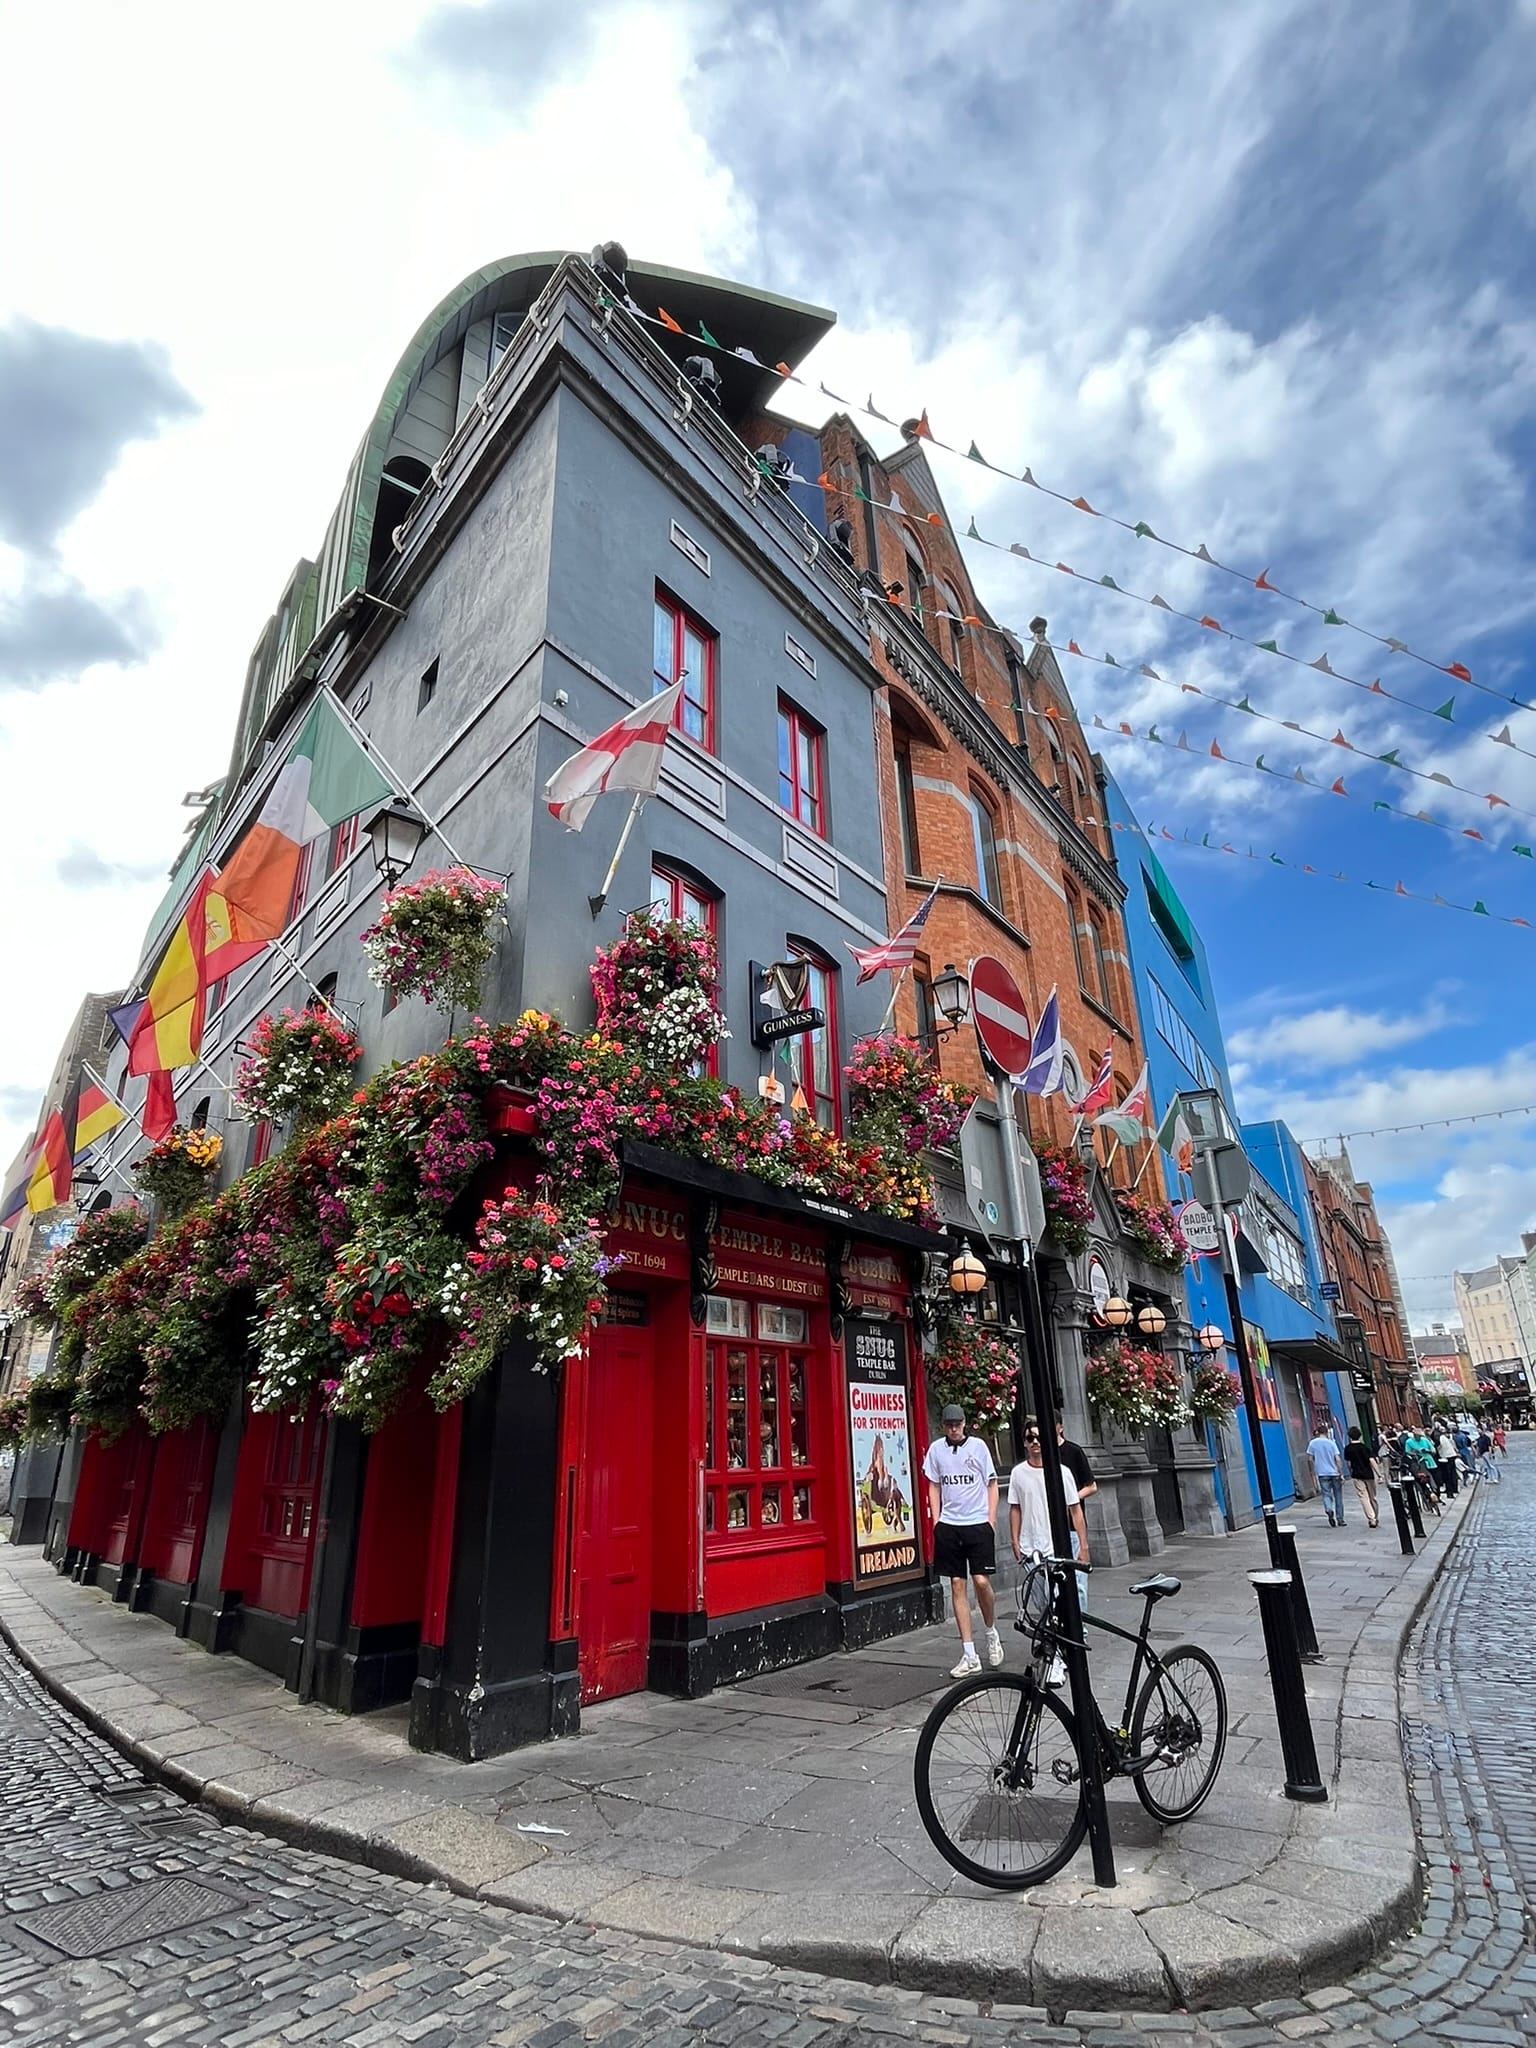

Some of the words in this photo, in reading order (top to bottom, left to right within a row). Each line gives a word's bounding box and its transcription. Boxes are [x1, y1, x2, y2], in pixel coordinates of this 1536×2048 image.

[763, 1011, 813, 1035] GUINNESS
[1183, 1213, 1213, 1225] BADBO
[1186, 1226, 1211, 1236] TEMPLE
[644, 1254, 666, 1270] 1694
[790, 1241, 826, 1268] BAR
[848, 1256, 902, 1283] DUBLIN
[717, 1266, 749, 1284] EMPLE
[776, 1277, 807, 1294] OLDEST
[869, 1326, 881, 1335] THE
[855, 1335, 895, 1359] SNUG
[856, 1357, 882, 1369] TEMPLE
[882, 1360, 896, 1370] BAR
[868, 1371, 887, 1379] DUBLIN
[852, 1389, 904, 1411] GUINNESS
[853, 1417, 867, 1429] FOR
[869, 1417, 905, 1430] STRENGTH
[860, 1546, 916, 1574] IRELAND
